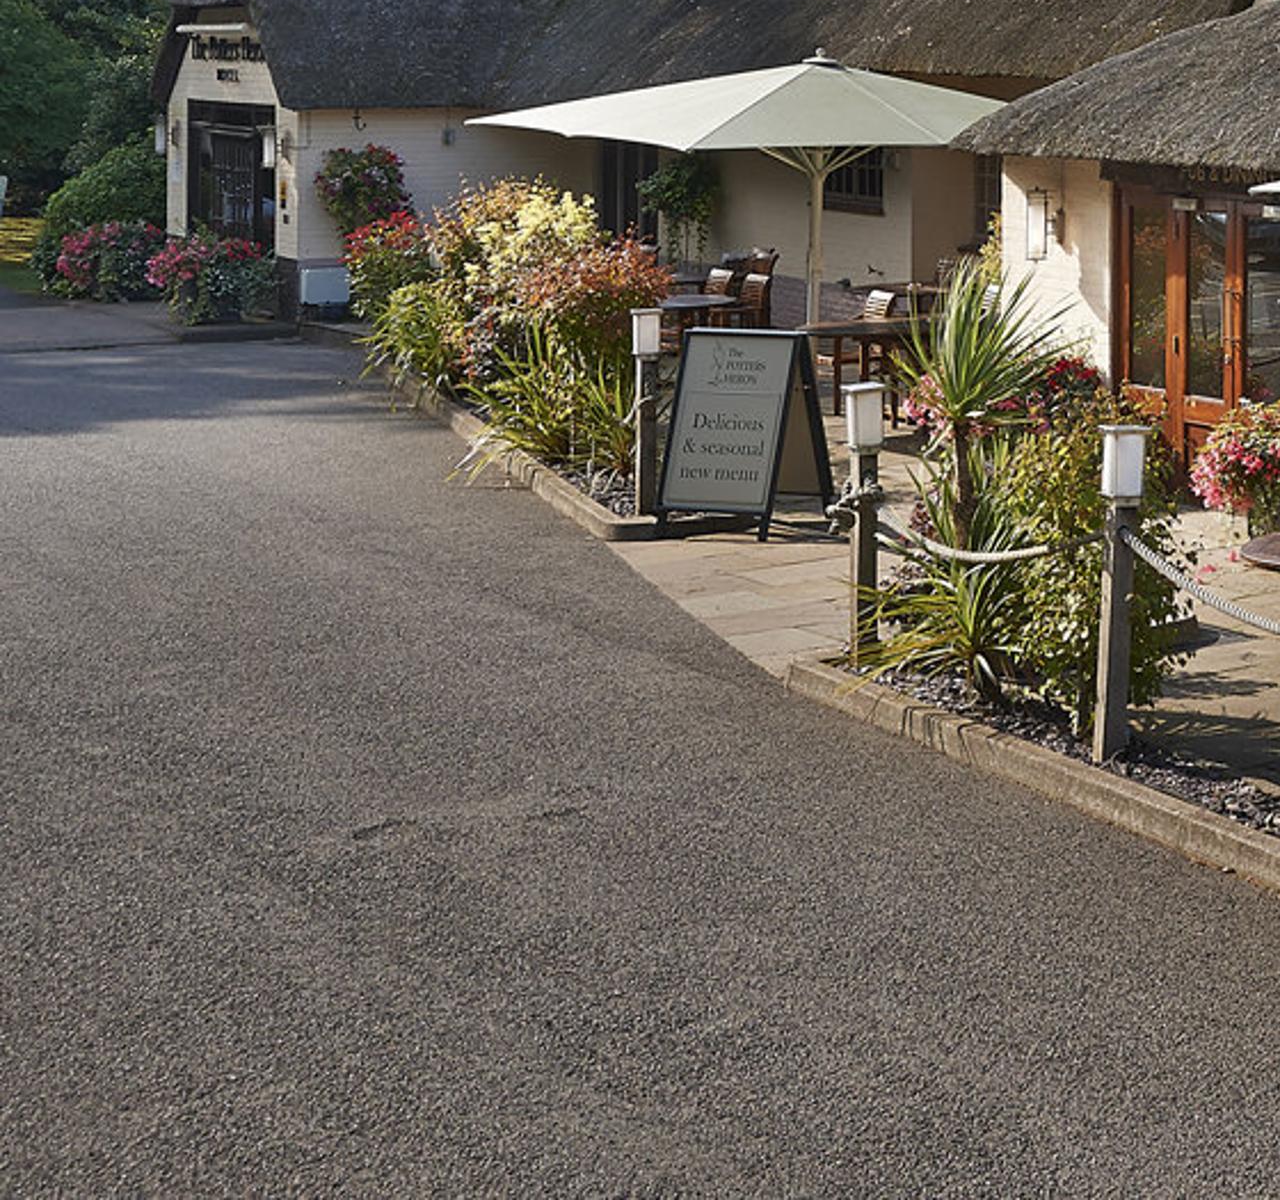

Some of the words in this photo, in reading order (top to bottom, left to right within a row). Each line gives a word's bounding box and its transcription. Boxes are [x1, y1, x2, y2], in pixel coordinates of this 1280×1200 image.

[728, 347, 744, 358] The
[692, 412, 765, 432] Delicious
[682, 438, 697, 454] &
[700, 440, 765, 457] seasonal
[679, 466, 712, 480] new
[714, 468, 760, 483] menu
